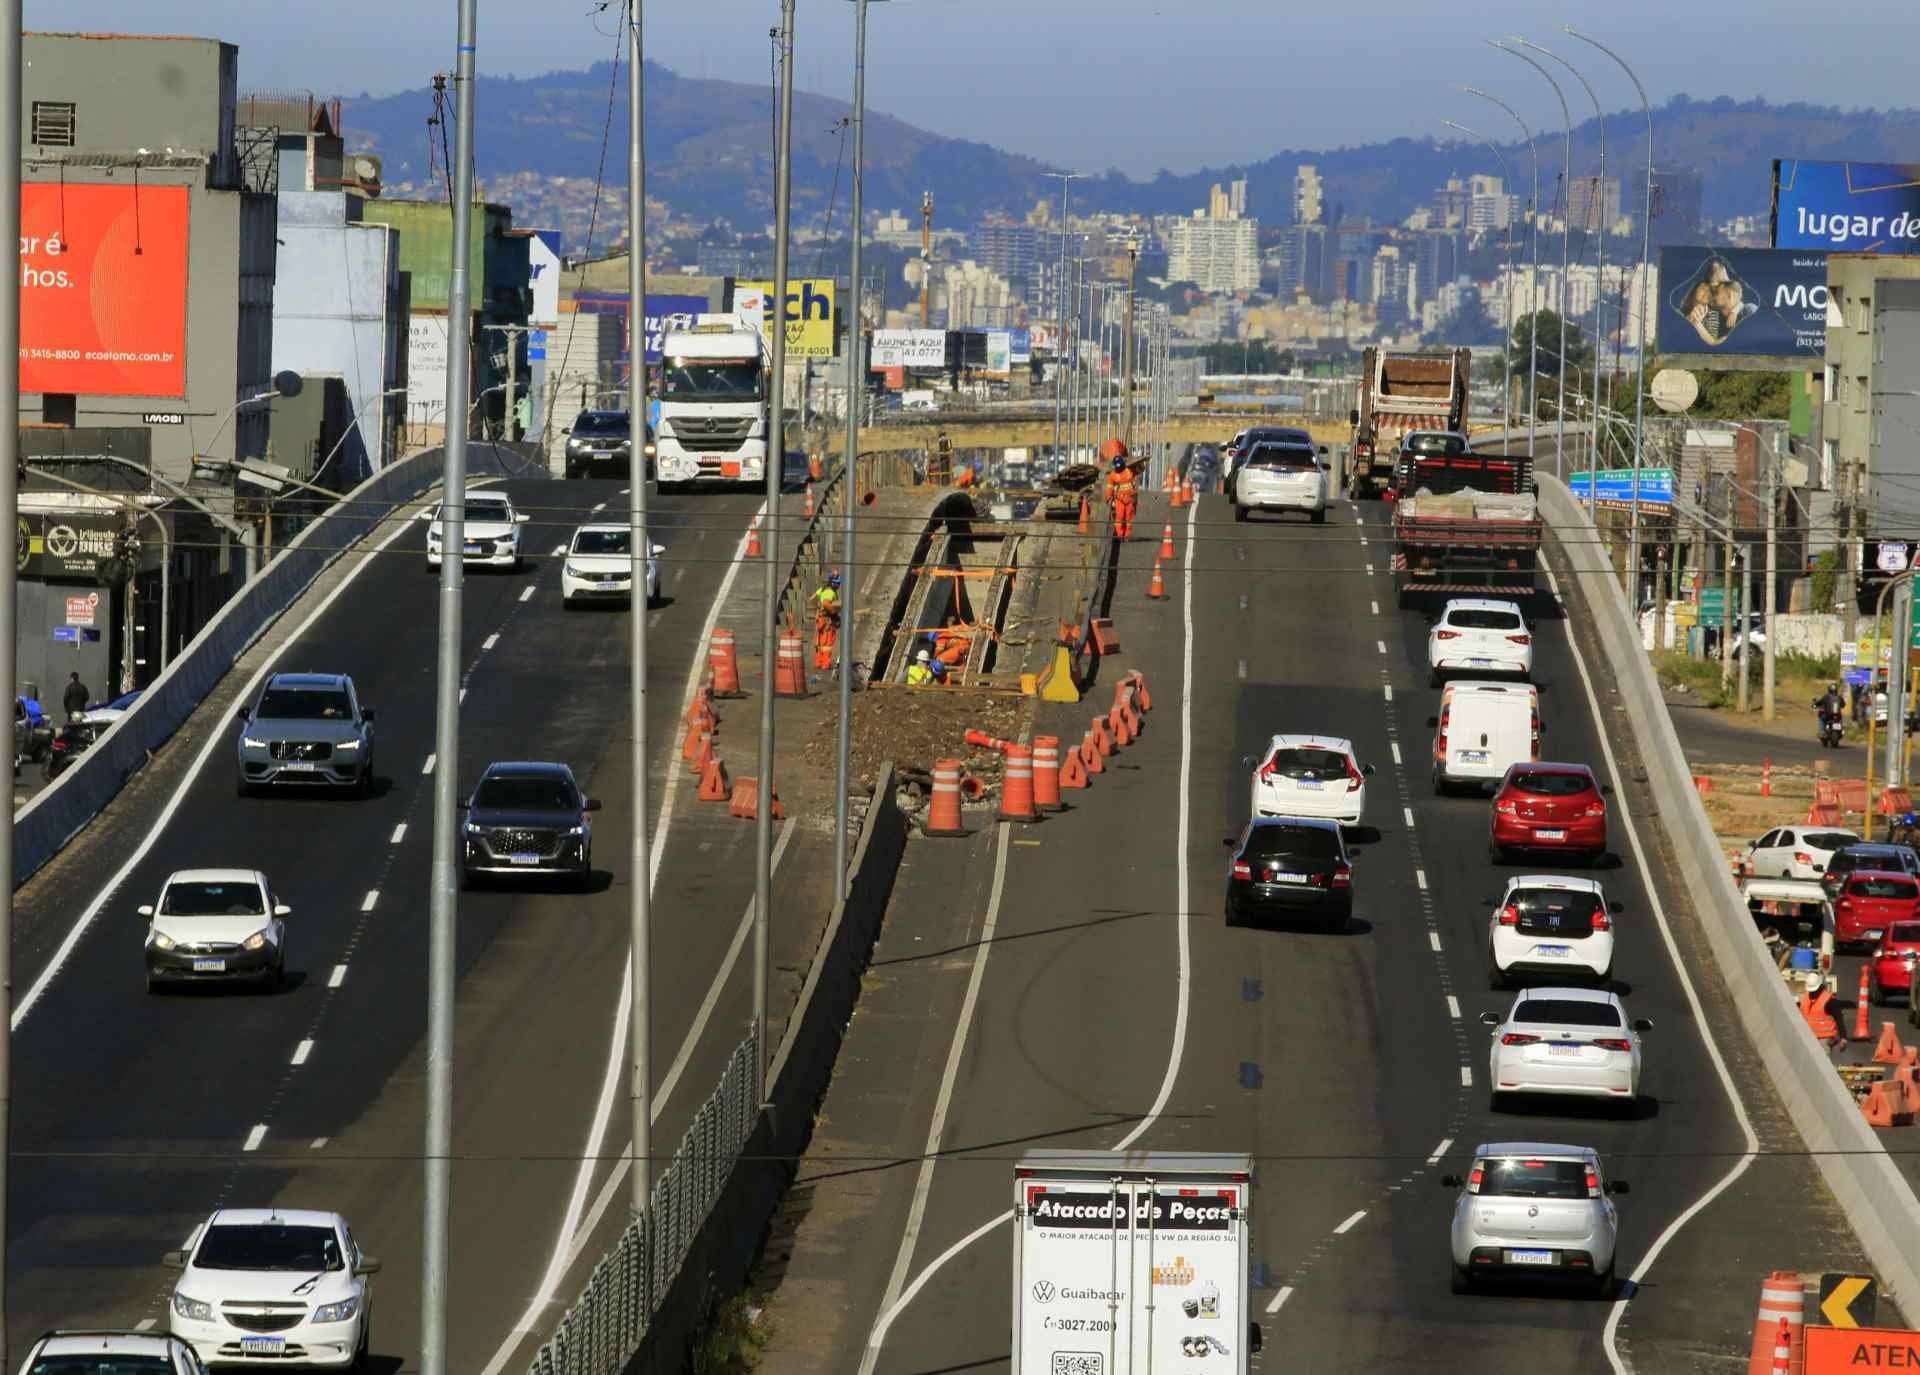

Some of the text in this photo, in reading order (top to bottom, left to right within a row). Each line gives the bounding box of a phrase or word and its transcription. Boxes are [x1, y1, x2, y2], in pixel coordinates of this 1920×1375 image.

[1798, 207, 1884, 242] lugar
[46, 232, 61, 255] é
[23, 263, 74, 288] hos.
[1036, 1199, 1230, 1225] Atacado de Peças
[1191, 1232, 1221, 1241] REGIÃO
